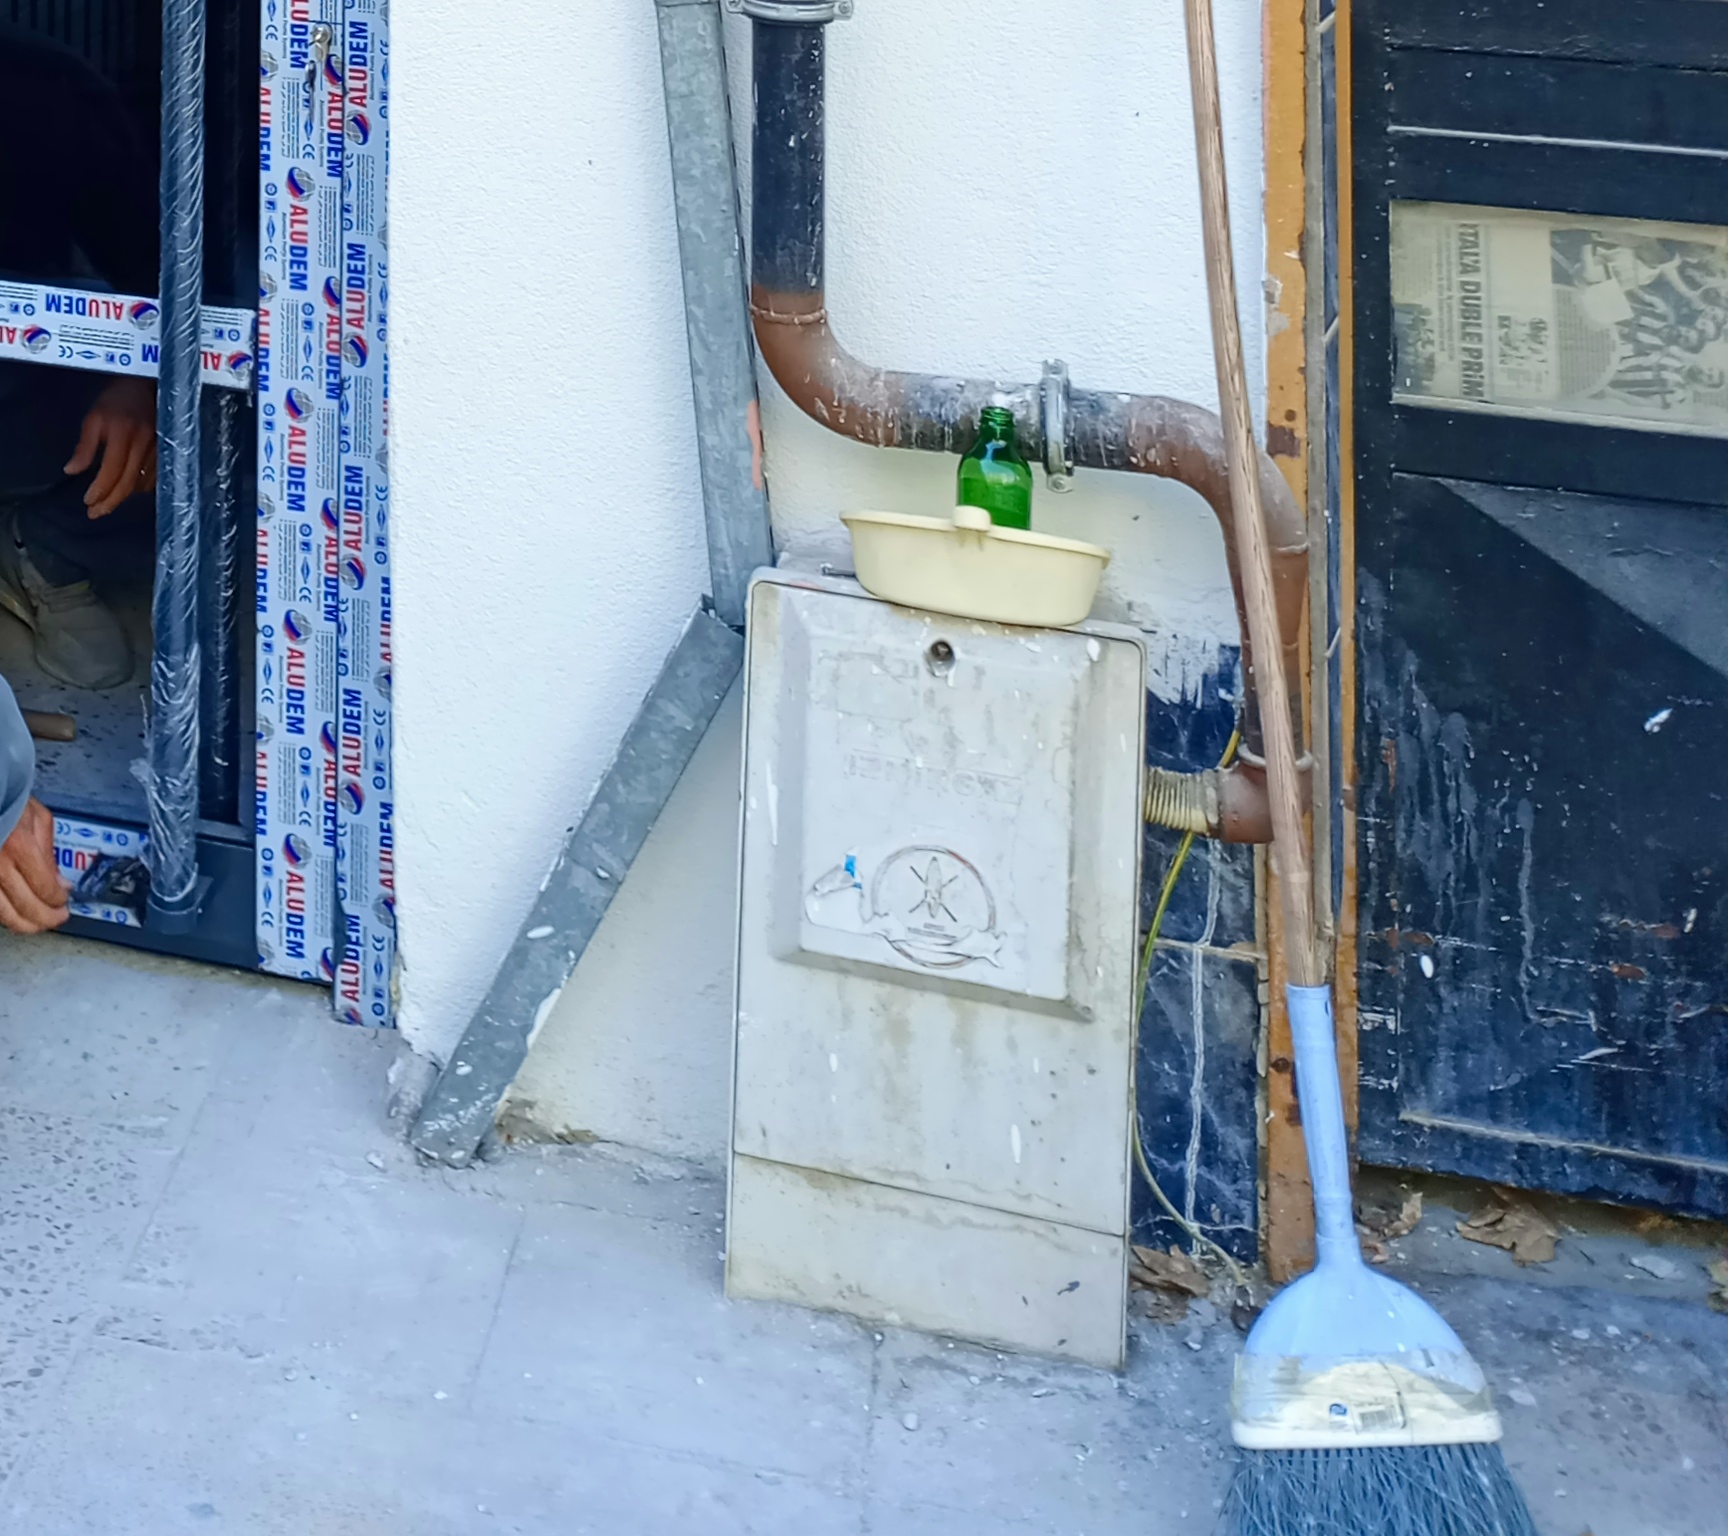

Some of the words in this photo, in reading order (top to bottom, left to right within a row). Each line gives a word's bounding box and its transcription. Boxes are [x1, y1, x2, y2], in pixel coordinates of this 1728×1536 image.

[348, 21, 368, 107] ALUDEM
[325, 91, 343, 177] ALUDEM
[288, 204, 309, 291] ALUDEM
[346, 243, 366, 330] ALUDEM
[45, 292, 124, 320] ALUDEM
[1459, 280, 1483, 343] DUBLE
[324, 314, 342, 400] ALUDEM
[286, 425, 307, 512] ALUDEM
[343, 465, 363, 551] ALUDEM
[323, 535, 339, 621] ALUDEM
[285, 647, 306, 735] ALUDEM
[341, 688, 363, 777] ALUDEM
[322, 759, 337, 846] ALUDEM
[285, 870, 305, 958] ALUDEM
